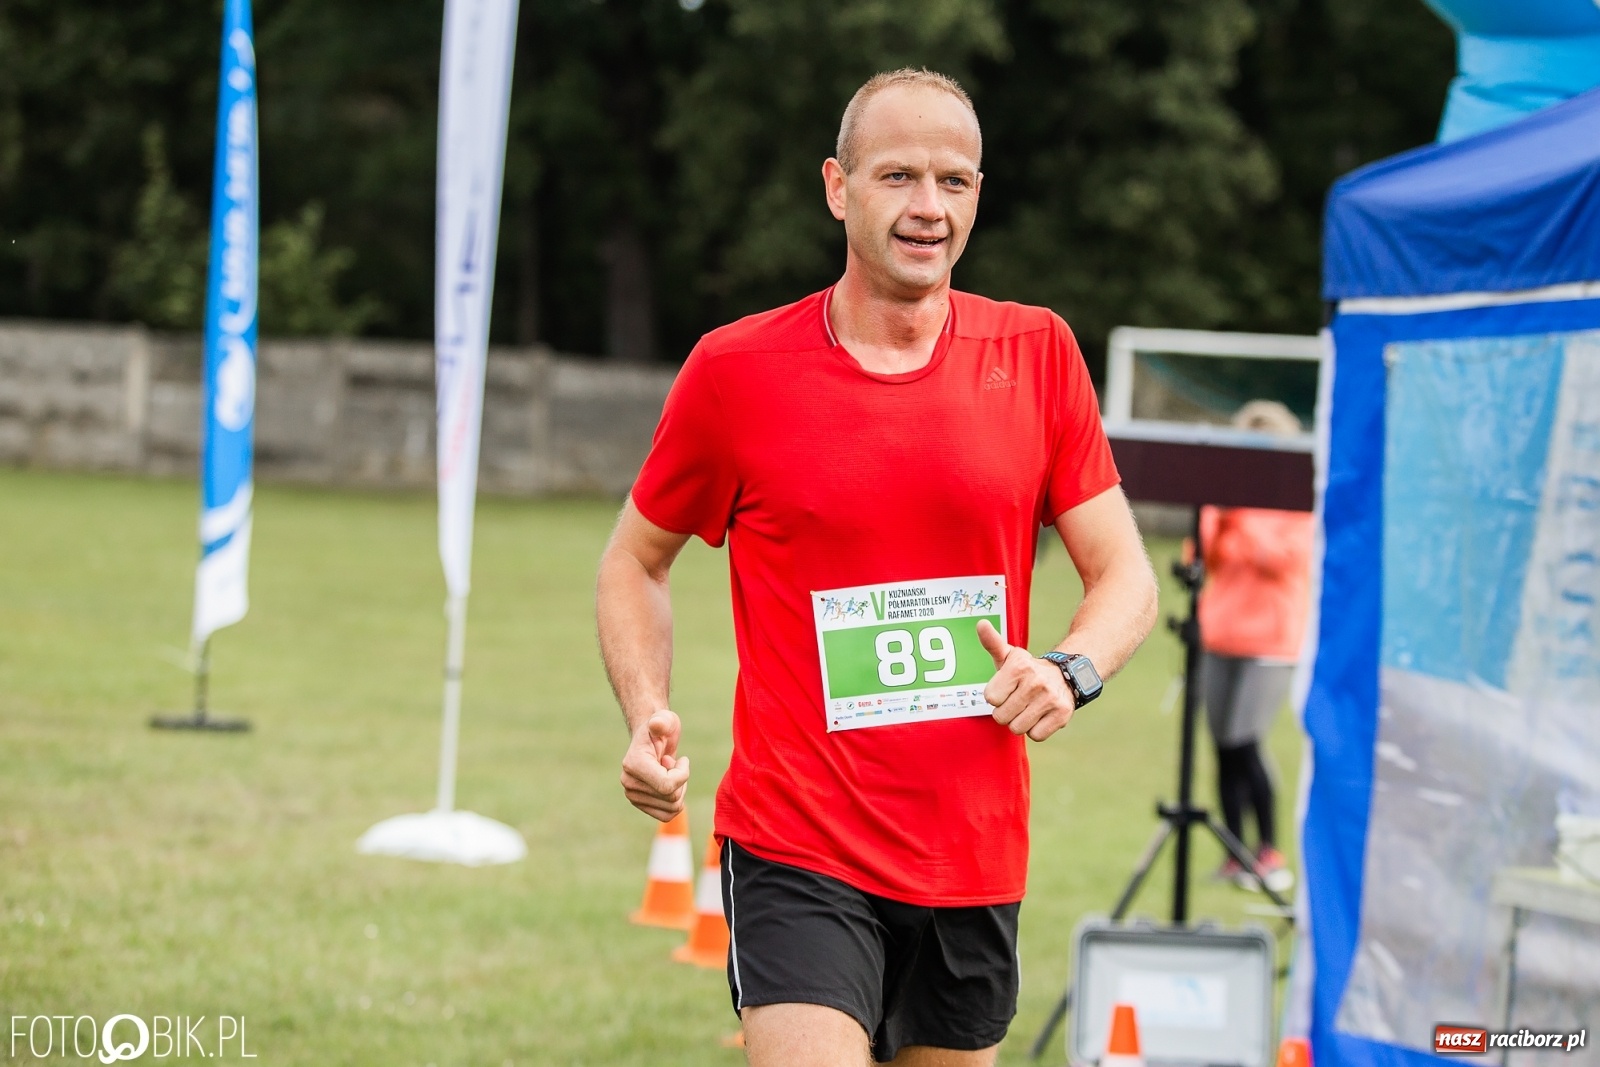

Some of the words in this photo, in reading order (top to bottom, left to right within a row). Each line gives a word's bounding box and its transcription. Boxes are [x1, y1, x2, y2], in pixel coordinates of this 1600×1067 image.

[984, 379, 1017, 391] adidas
[870, 591, 886, 620] V
[888, 598, 931, 610] PÓŁMARATON
[931, 595, 951, 606] LEŚNY
[888, 608, 918, 620] RAFAMET
[919, 607, 935, 617] 2020
[874, 625, 957, 688] 89
